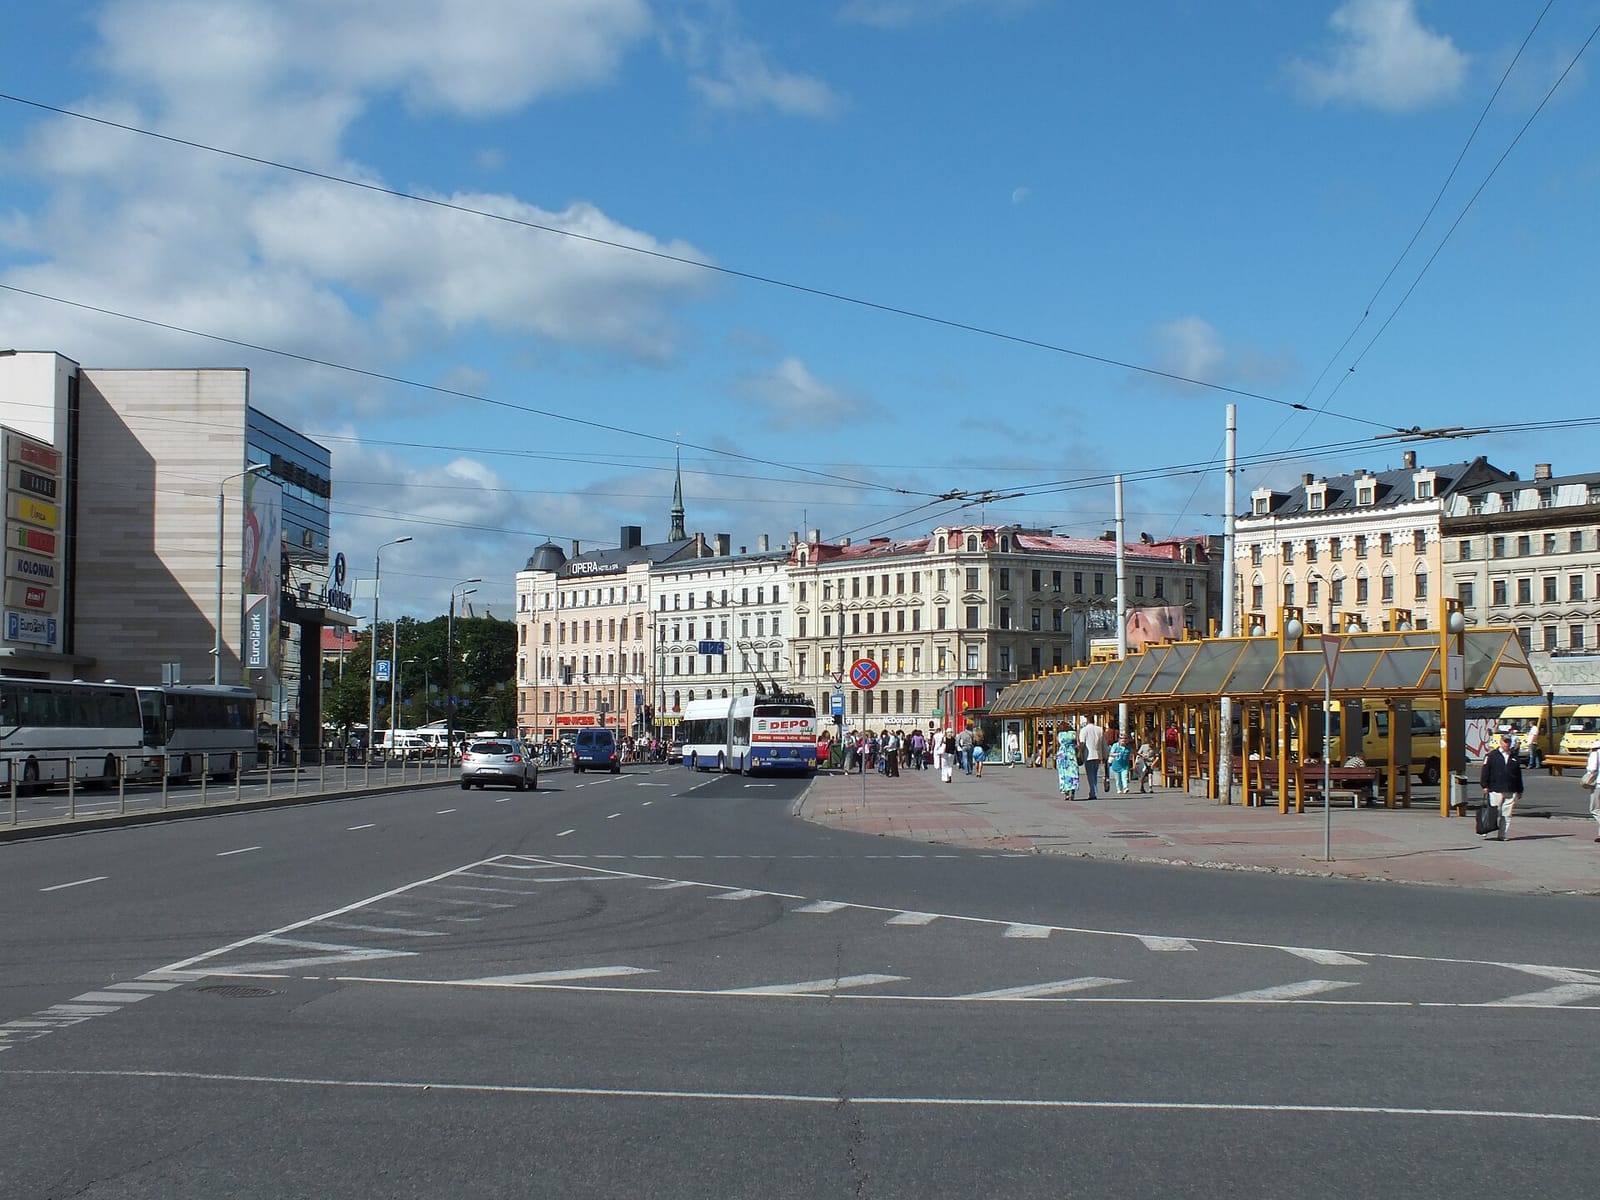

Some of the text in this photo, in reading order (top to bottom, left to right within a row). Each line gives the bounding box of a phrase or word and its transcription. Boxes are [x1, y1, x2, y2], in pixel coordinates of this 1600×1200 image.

[17, 559, 54, 578] KOLONNA
[572, 561, 598, 574] OPERA
[249, 615, 262, 666] EuroPark
[769, 719, 810, 730] DEPO
